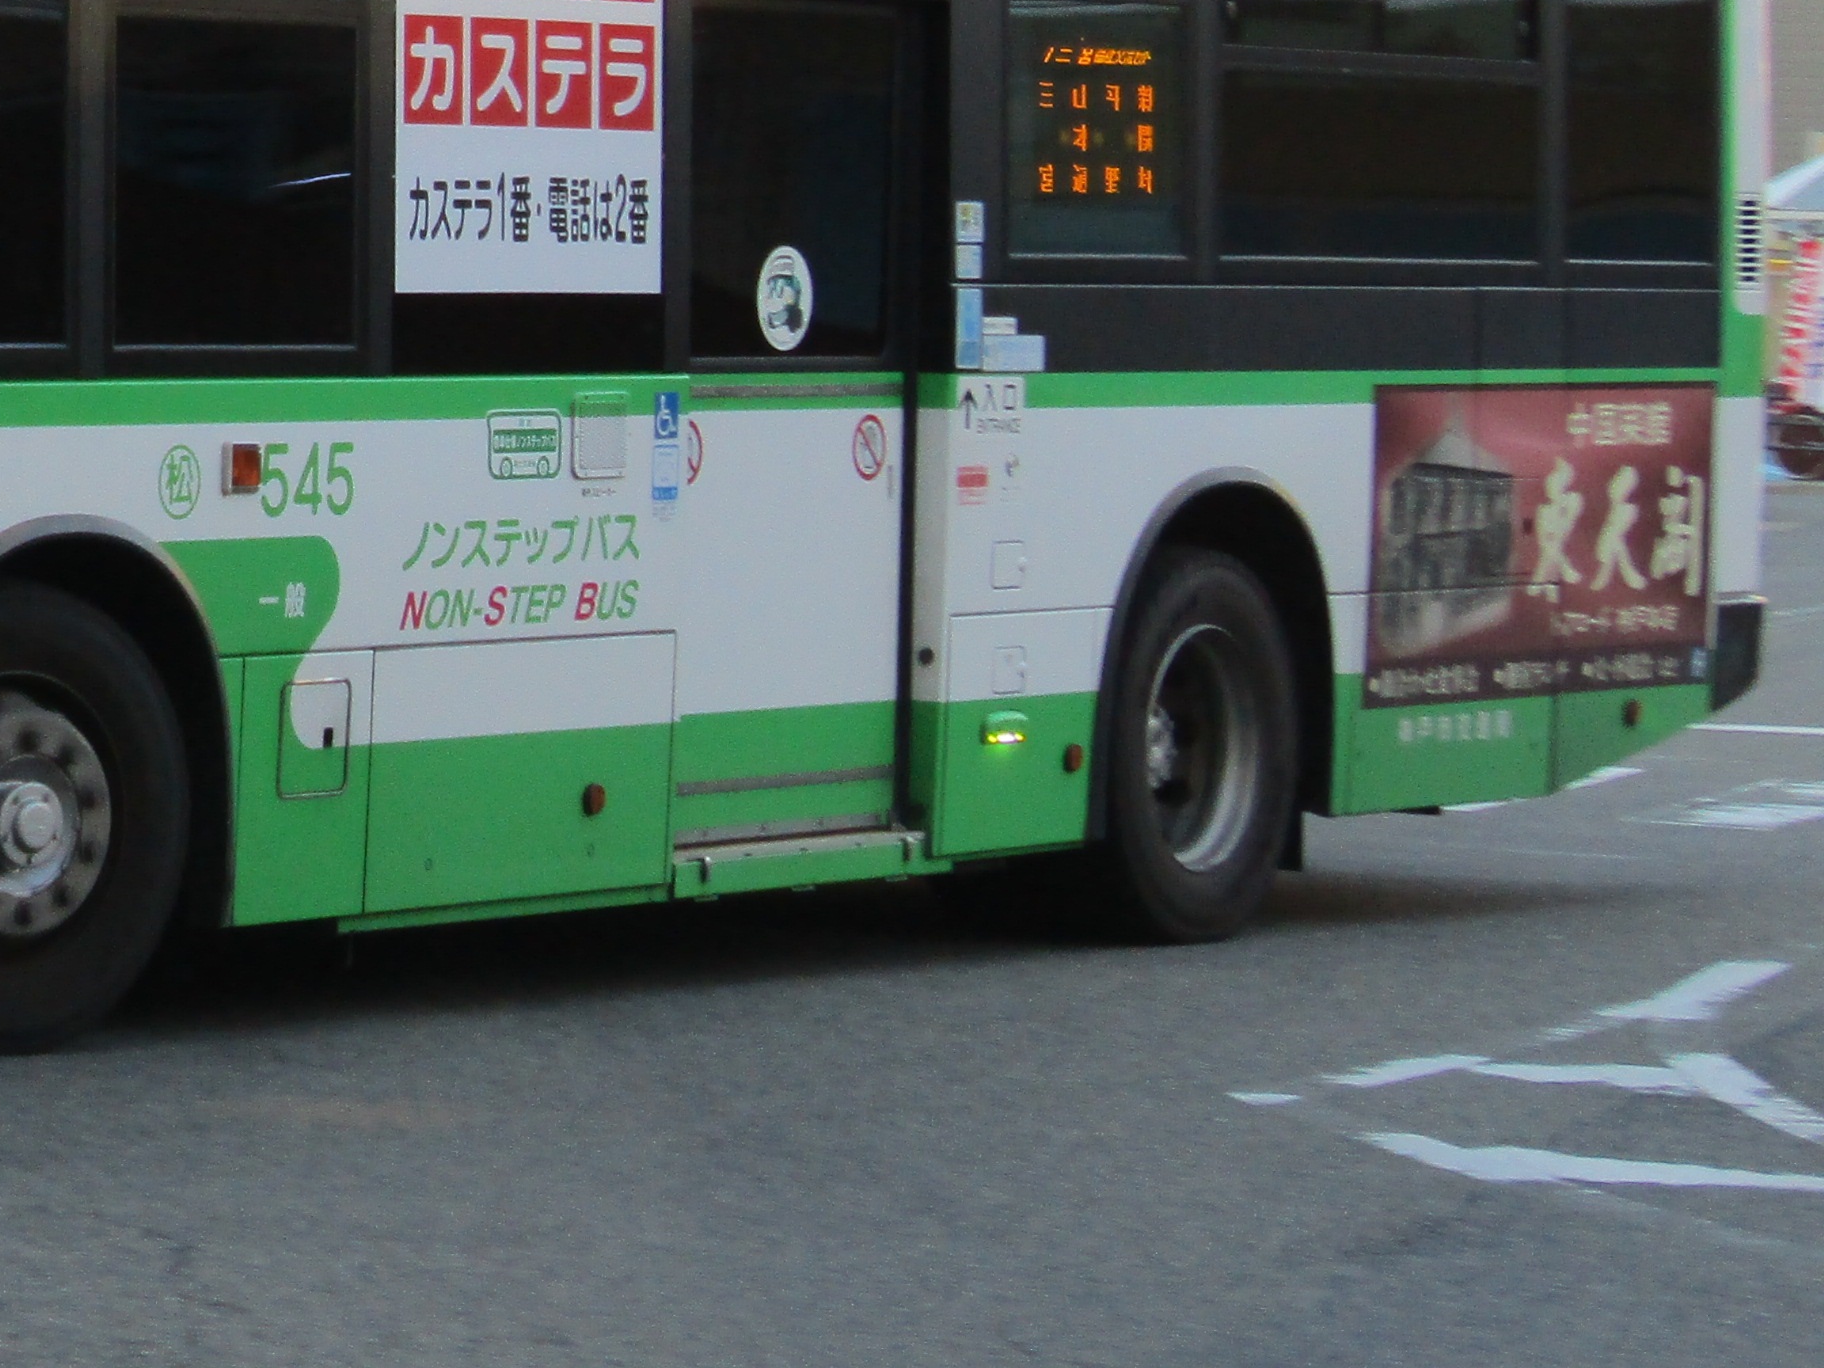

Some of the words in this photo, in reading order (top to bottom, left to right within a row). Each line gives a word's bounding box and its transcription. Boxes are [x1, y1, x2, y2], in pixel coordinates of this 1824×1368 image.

[408, 26, 648, 117] カステラ
[260, 441, 355, 518] 545
[402, 514, 641, 571] ノンステップバス
[258, 581, 307, 618] 一般
[399, 583, 566, 630] NON-STEP
[573, 579, 641, 621] BUS
